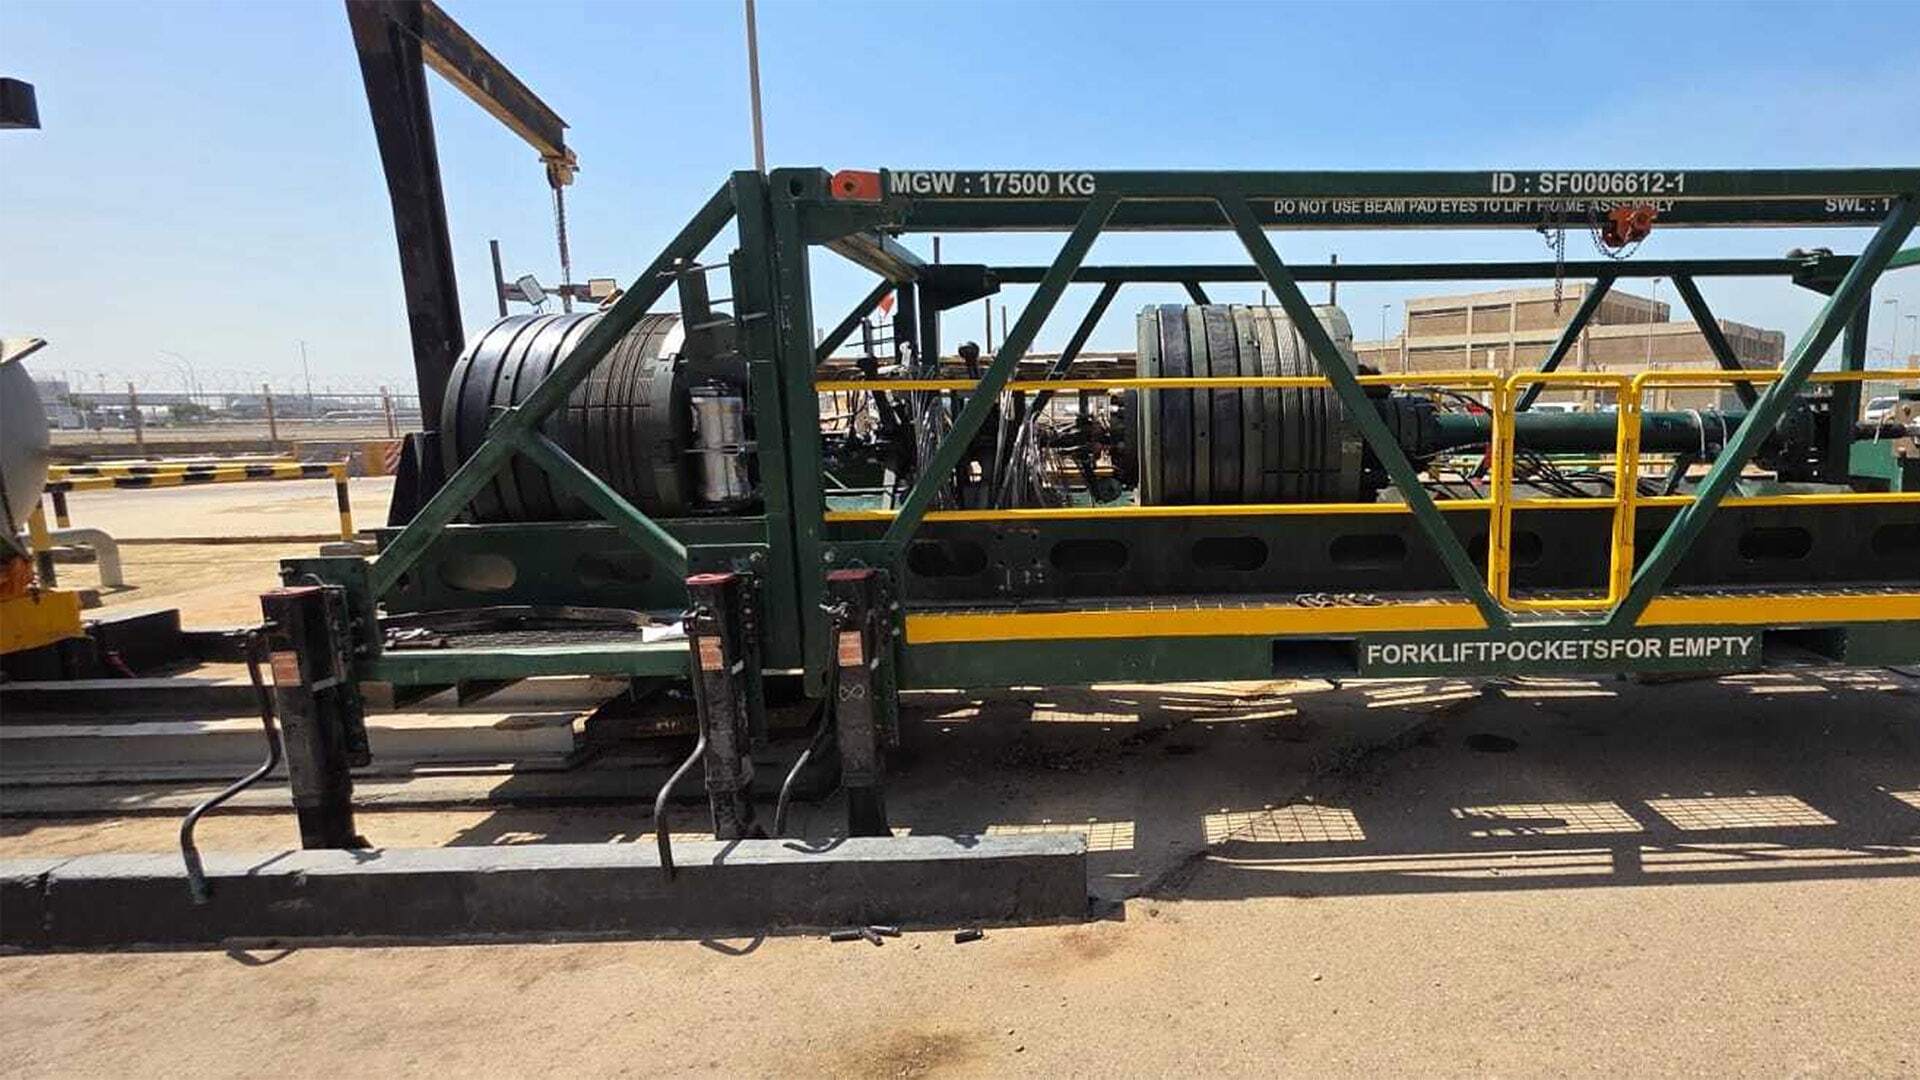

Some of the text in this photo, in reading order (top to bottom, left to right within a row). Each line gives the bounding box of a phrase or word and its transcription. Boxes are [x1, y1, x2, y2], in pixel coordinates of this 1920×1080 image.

[890, 173, 955, 195] MGW
[979, 173, 1050, 195] 17500
[1059, 174, 1096, 195] KG
[1492, 174, 1517, 193] ID
[1539, 173, 1686, 194] SF0006612-1
[1274, 200, 1295, 213] DO
[1299, 200, 1328, 213] NOT
[1333, 200, 1361, 213] USE
[1365, 200, 1406, 213] BEAM
[1410, 200, 1437, 213] PAD
[1441, 200, 1478, 213] EYES
[1537, 199, 1585, 212] FME
[1825, 198, 1865, 212] SWL
[1367, 636, 1754, 663] FORKLIFTPOCKETSFOR EMPTY
